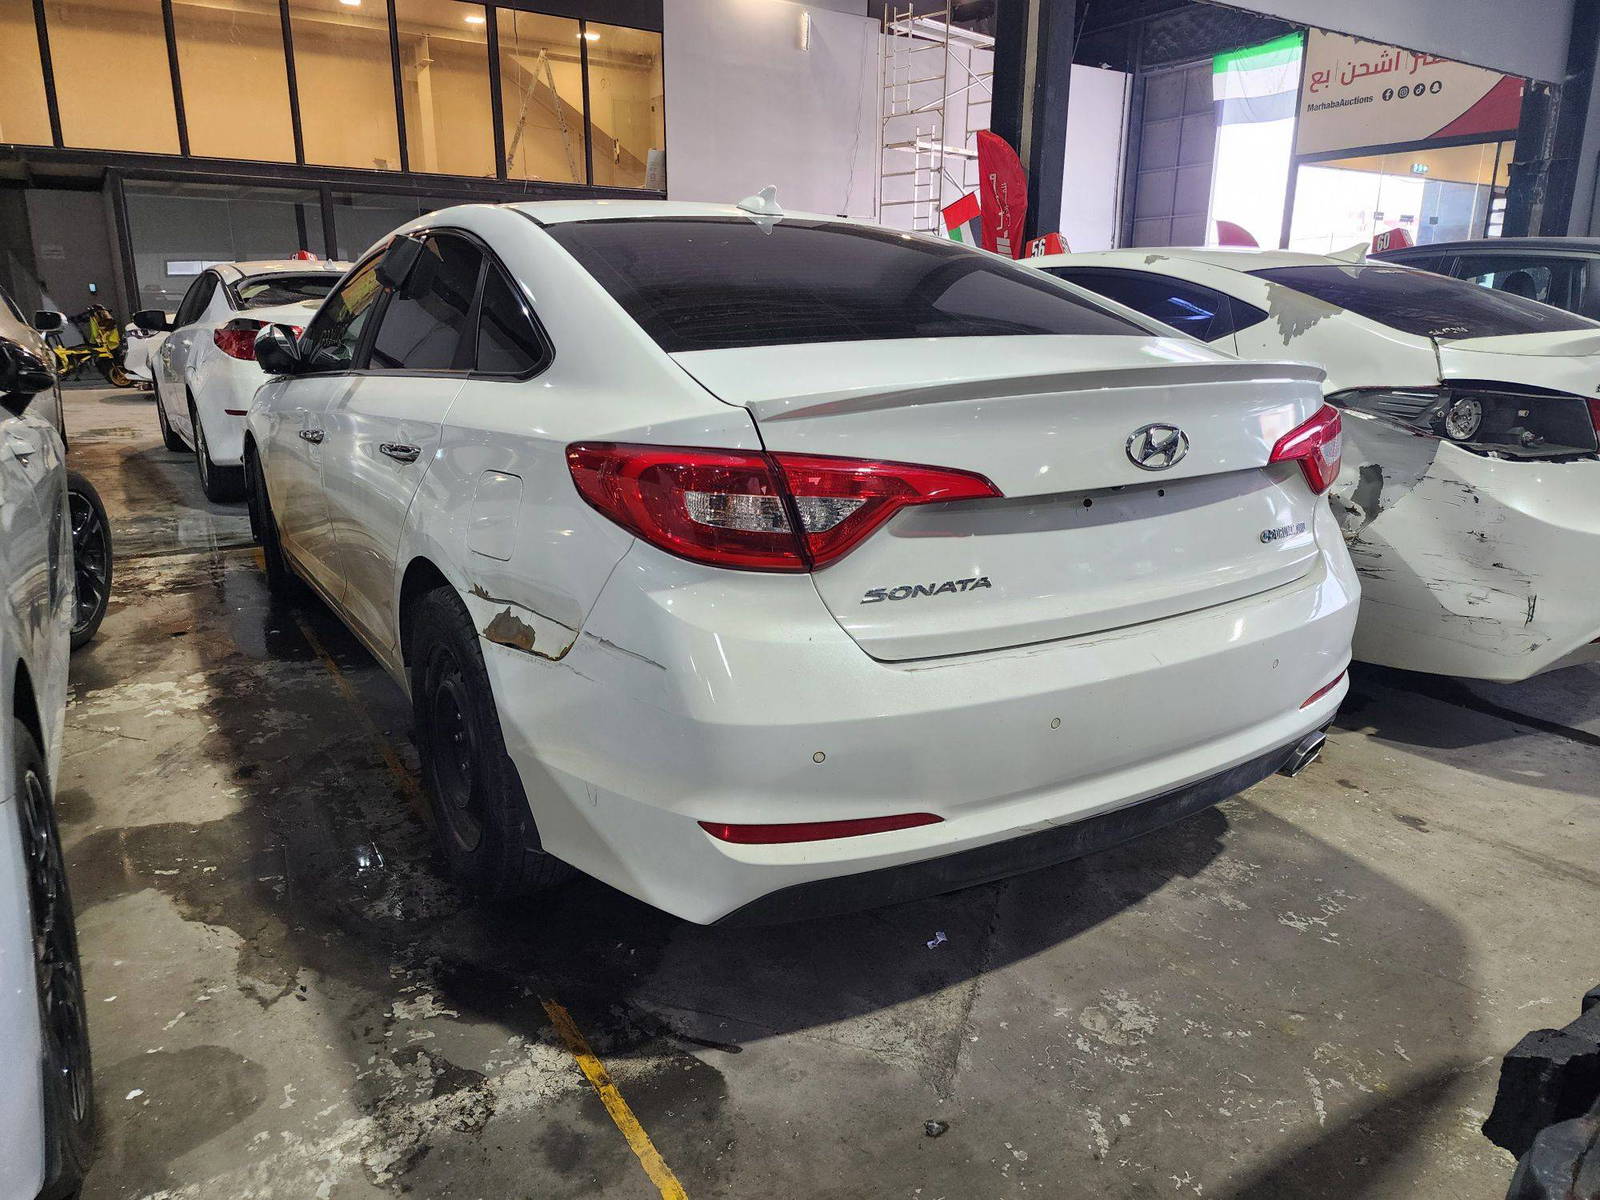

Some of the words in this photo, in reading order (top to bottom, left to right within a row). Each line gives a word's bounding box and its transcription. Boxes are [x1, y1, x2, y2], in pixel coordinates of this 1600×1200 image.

[1341, 50, 1401, 86] اشحن
[1310, 69, 1331, 93] بع
[1307, 95, 1374, 112] MarhabaAuctions
[1032, 238, 1046, 257] 56
[1377, 232, 1390, 252] 60
[860, 576, 992, 605] SONATA
